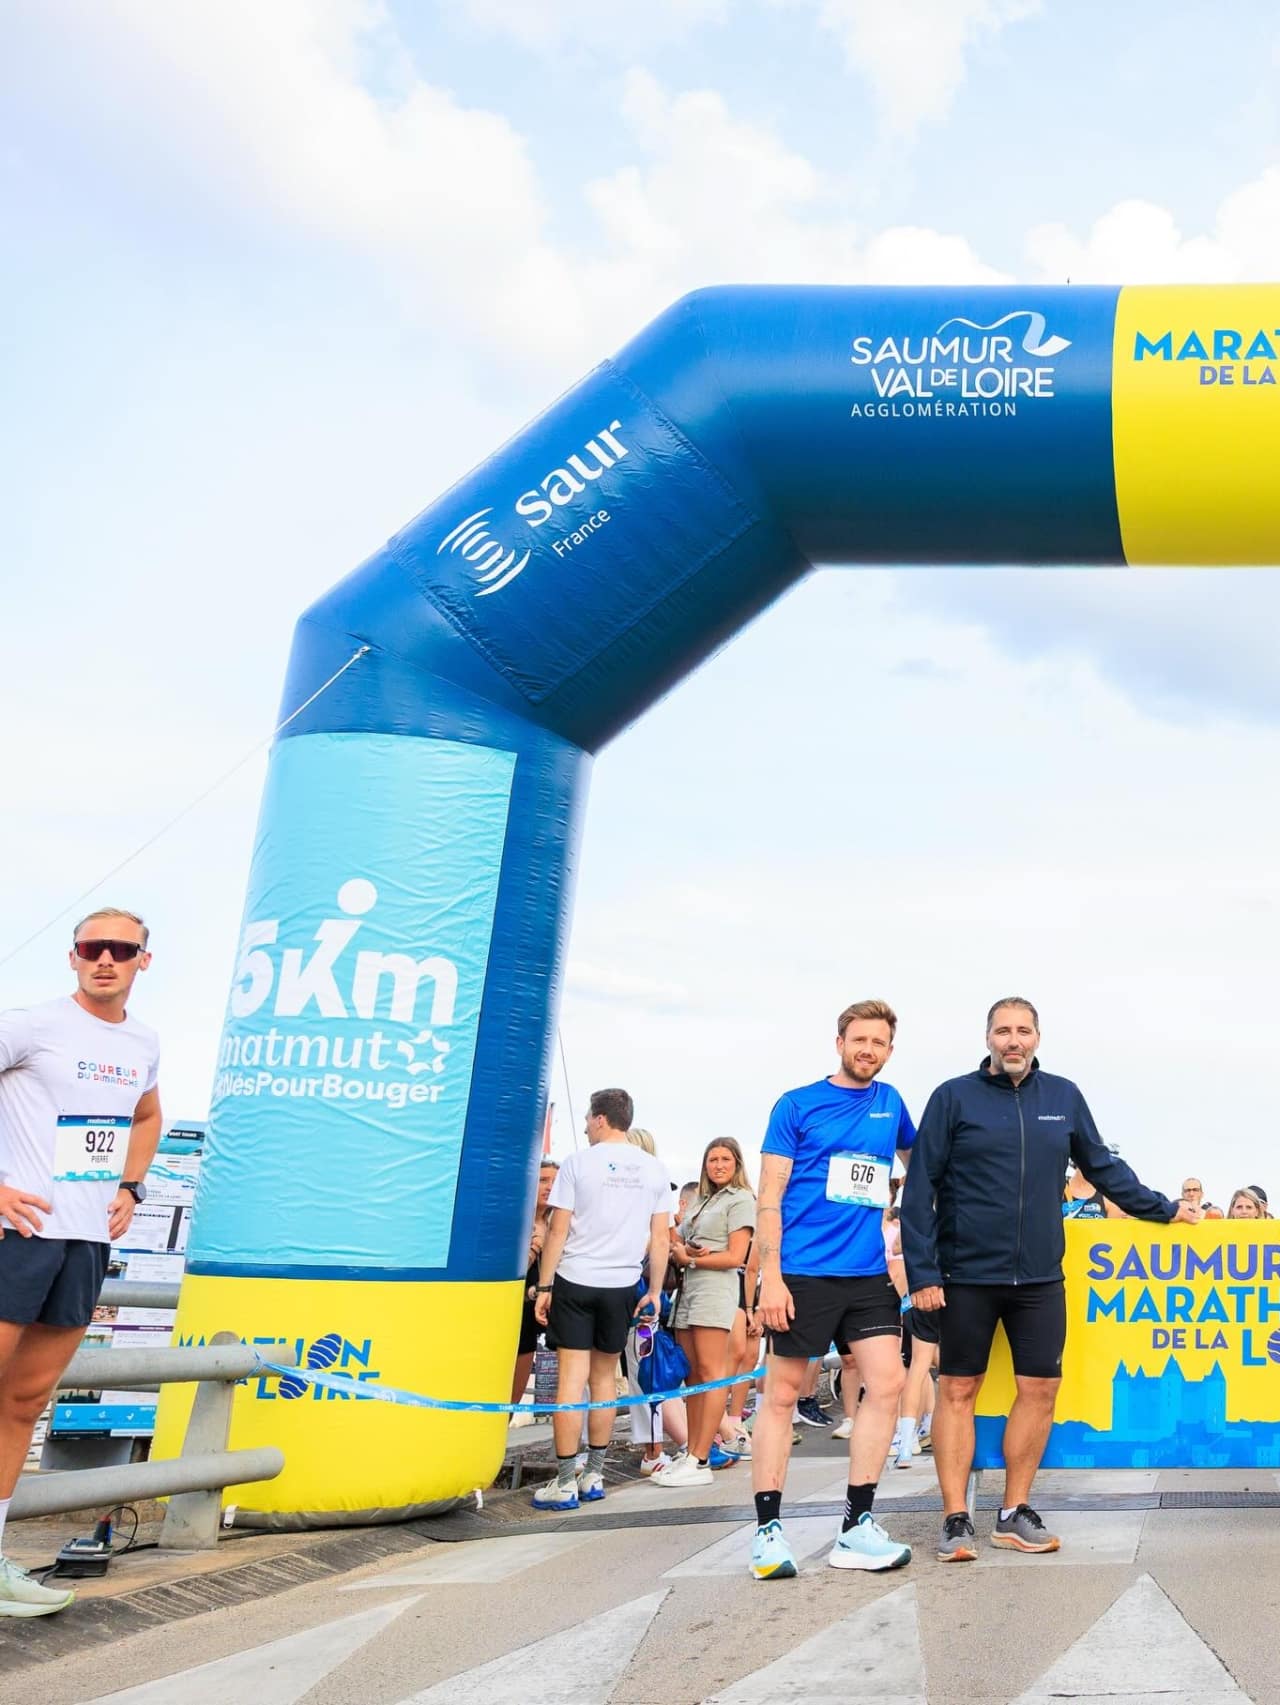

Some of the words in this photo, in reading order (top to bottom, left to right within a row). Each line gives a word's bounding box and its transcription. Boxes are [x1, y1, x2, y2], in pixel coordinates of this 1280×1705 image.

[851, 336, 1013, 364] SAUMUR
[870, 368, 934, 398] VAL
[930, 368, 957, 386] DE
[961, 367, 1055, 398] LOIRE
[1199, 365, 1234, 385] DE
[1242, 365, 1277, 385] LA
[851, 400, 1017, 417] AGGLOMÉRATION
[515, 419, 629, 528] saur
[551, 509, 612, 557] France
[219, 1028, 392, 1070] matmut
[77, 1061, 138, 1078] COUREUR
[77, 1071, 90, 1080] DU
[85, 1130, 115, 1153] 922
[851, 1163, 875, 1184] 676
[1152, 1328, 1187, 1349] DE
[1195, 1328, 1229, 1349] LA
